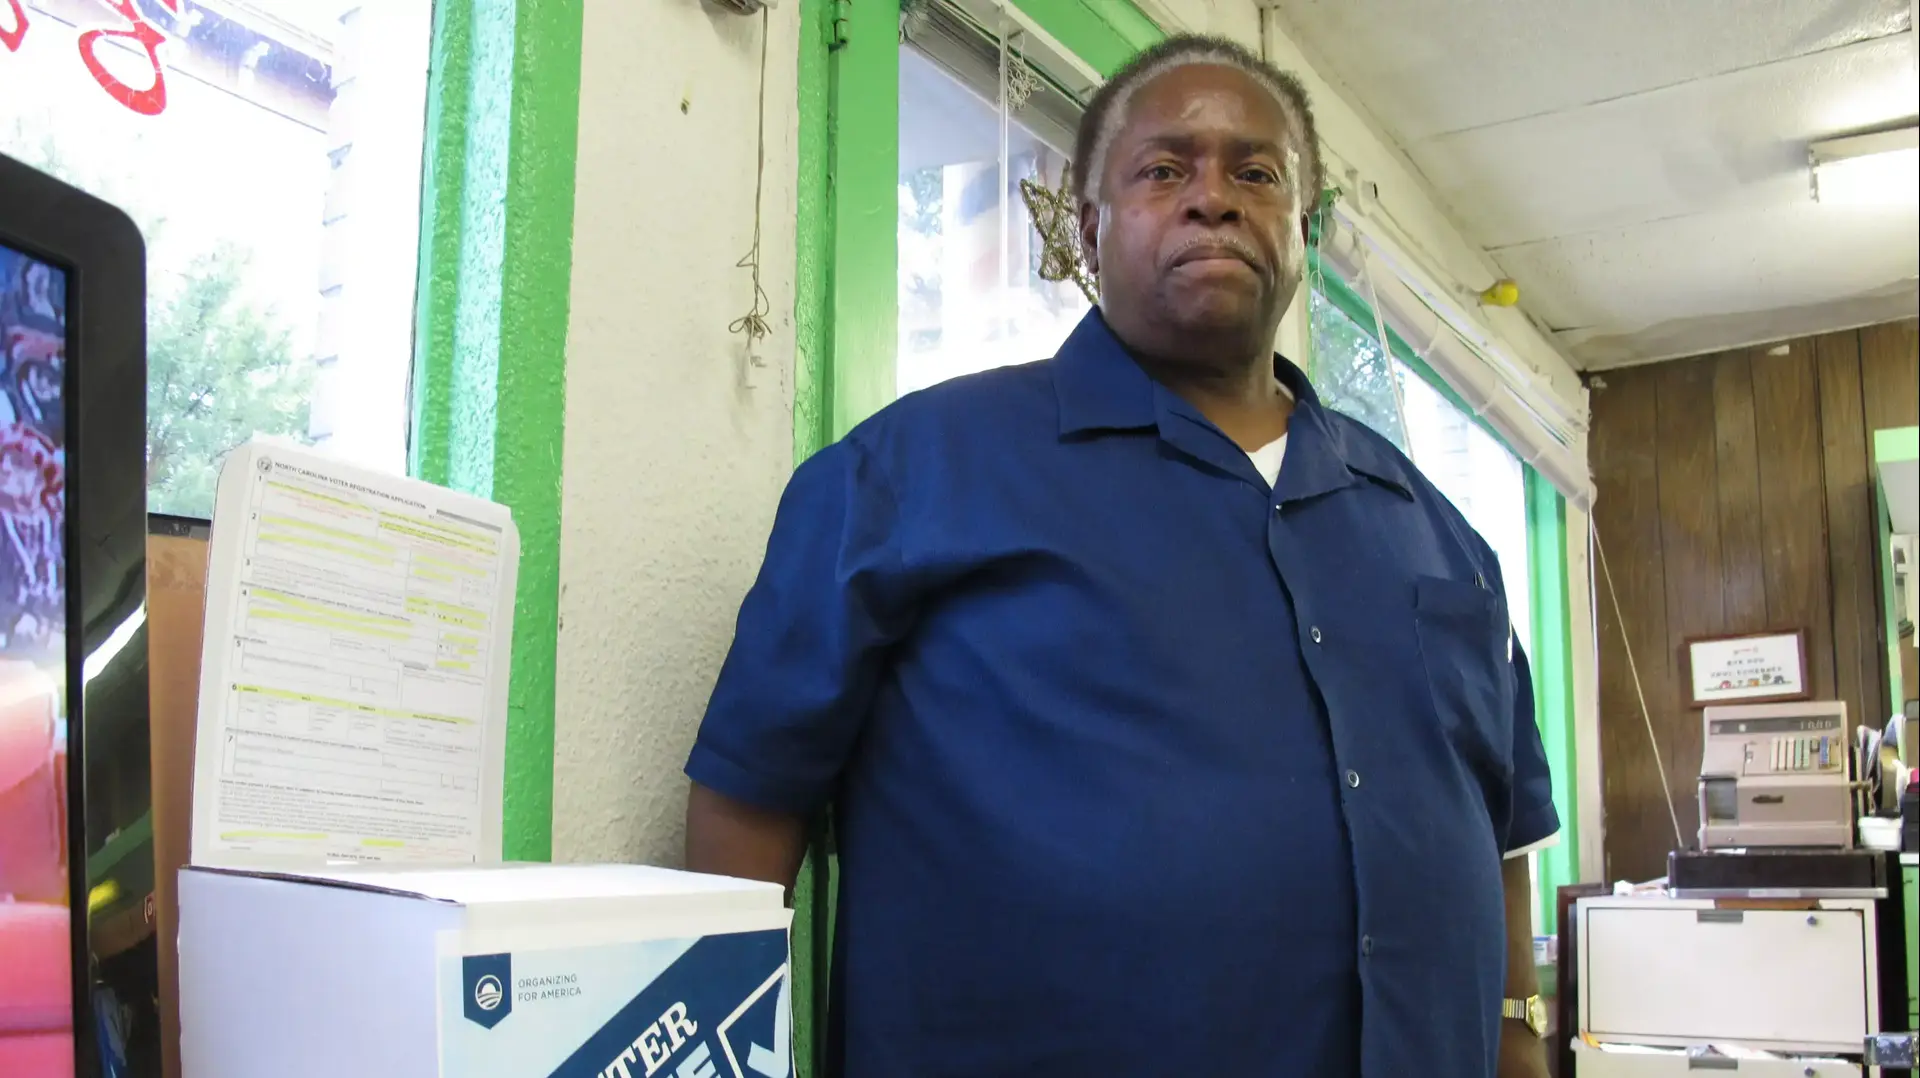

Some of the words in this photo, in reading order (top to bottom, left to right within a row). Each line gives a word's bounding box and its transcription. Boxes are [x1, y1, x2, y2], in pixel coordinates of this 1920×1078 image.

[275, 462, 297, 472] NORTH
[298, 467, 328, 481] CAROLINA
[329, 476, 348, 487] VOTER
[349, 481, 390, 500] REGISTRATION
[391, 495, 427, 510] APPLICATION
[517, 973, 578, 988] ORGANIZING
[518, 991, 538, 1003] FOR
[540, 986, 582, 1000] AMERICA
[597, 1001, 698, 1078] TER
